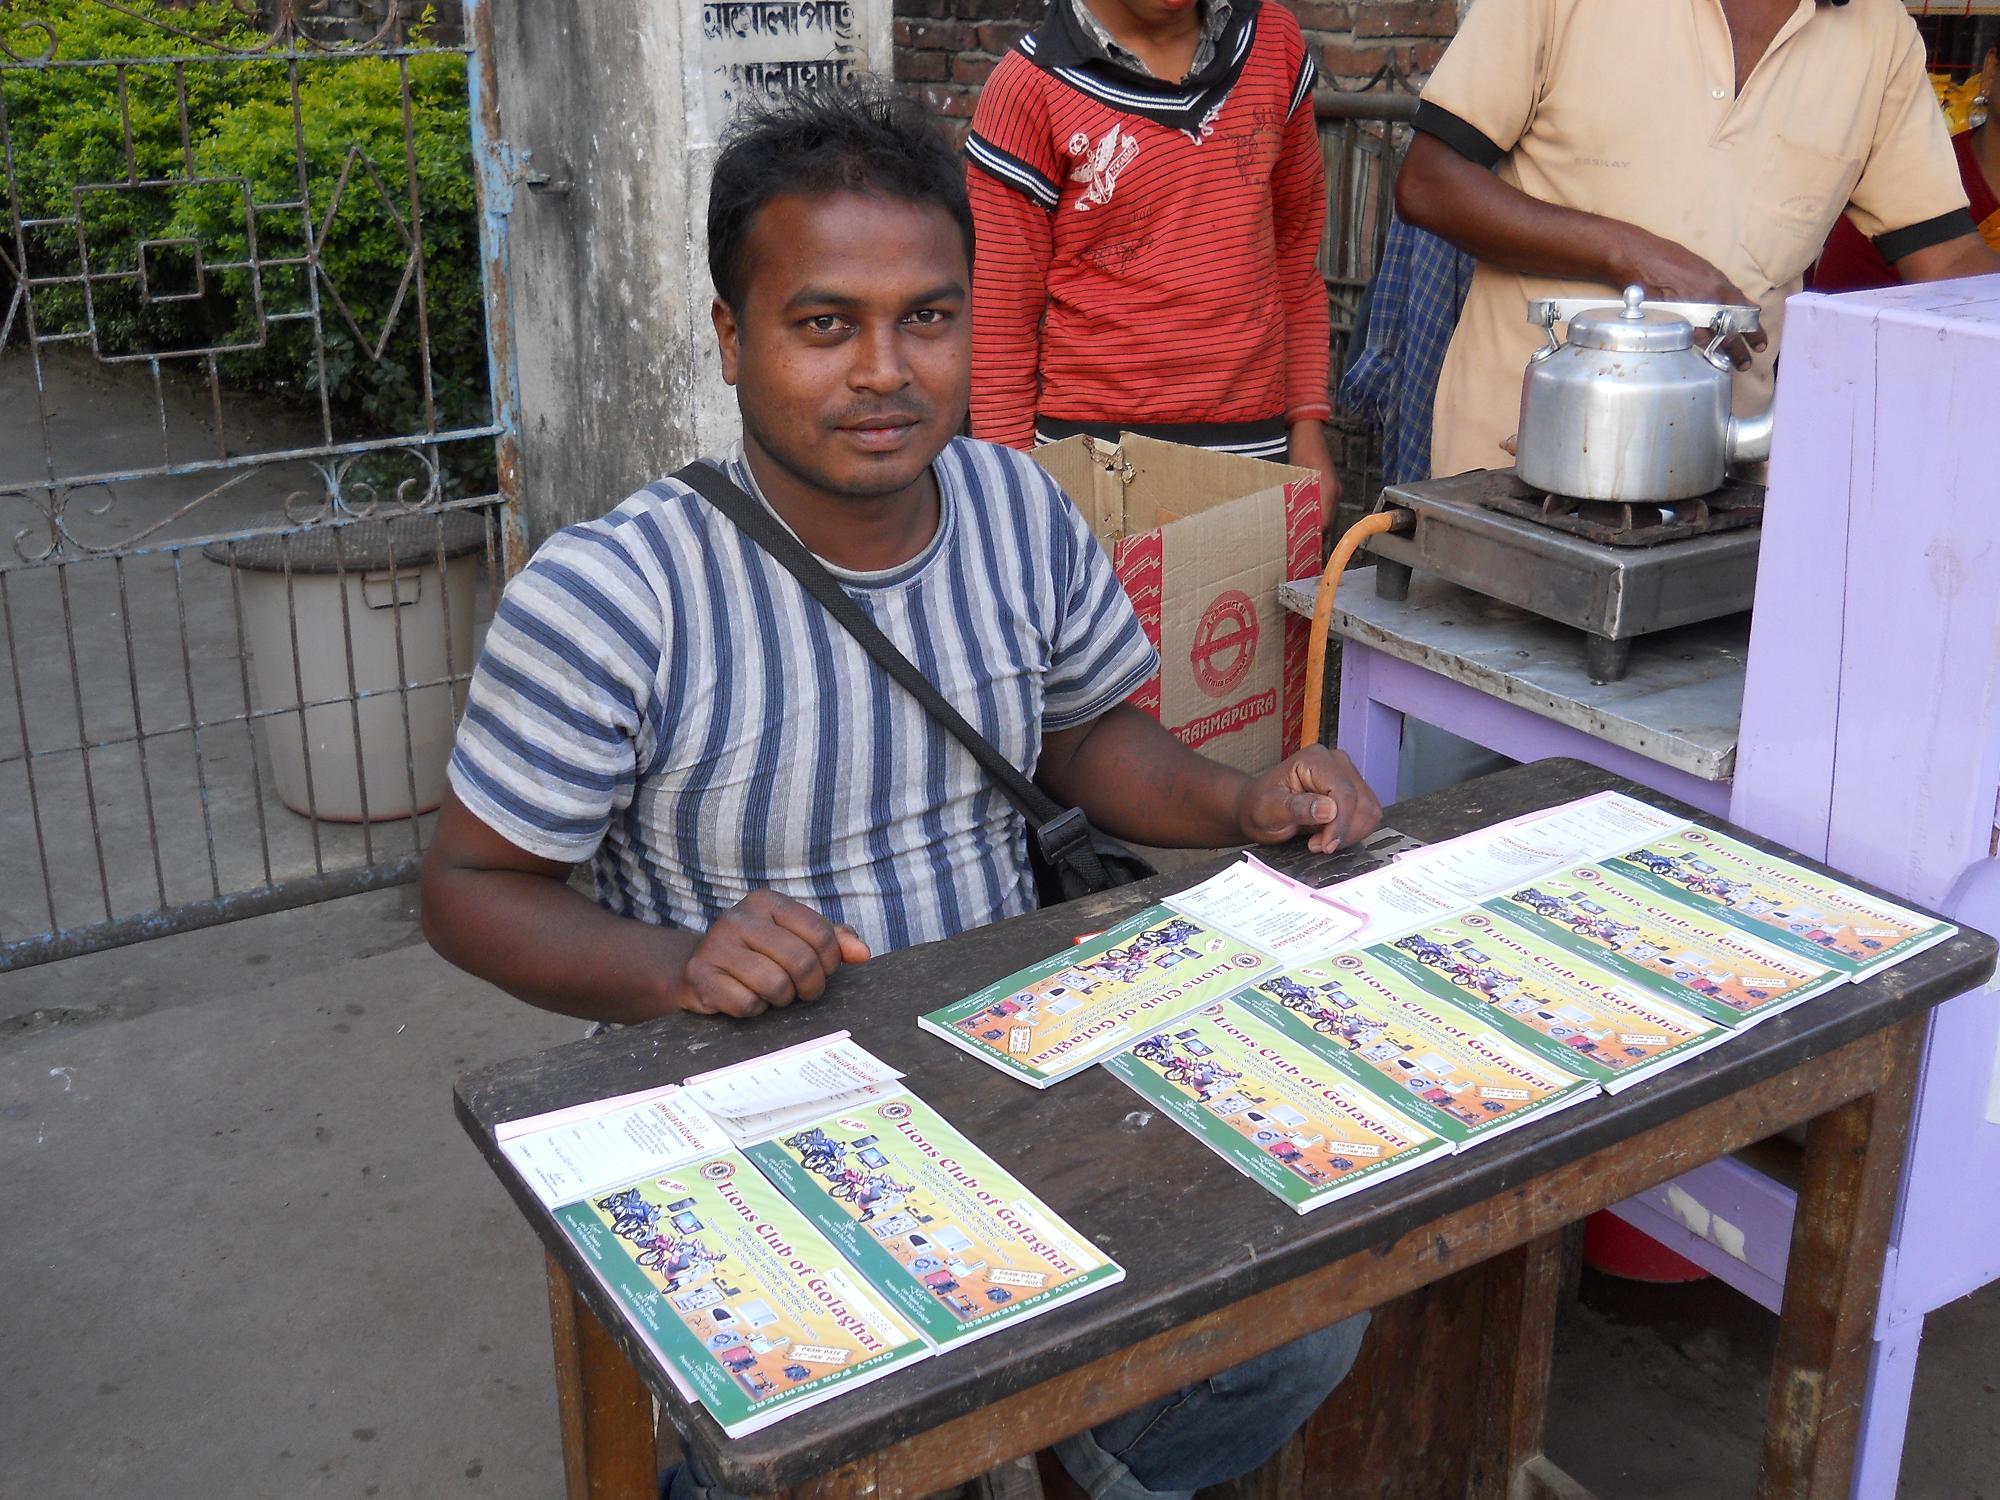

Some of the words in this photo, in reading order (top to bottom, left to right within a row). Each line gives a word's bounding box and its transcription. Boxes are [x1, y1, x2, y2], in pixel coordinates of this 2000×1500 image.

[1704, 841, 1750, 867] Lions
[1757, 864, 1798, 885] Club
[1800, 882, 1826, 894] of
[1826, 894, 1924, 935] Golaghat
[1598, 881, 1642, 907] Lions
[1647, 907, 1689, 928] Club
[1690, 925, 1716, 938] of
[1717, 937, 1810, 983] Golaghat
[1183, 963, 1231, 989] Lions
[1484, 927, 1530, 955] Lions
[1533, 955, 1575, 979] Club
[1575, 978, 1601, 992] of
[1601, 991, 1692, 1042] Golaghat
[1140, 989, 1183, 1009] Club
[1114, 1007, 1140, 1022] of
[942, 1021, 983, 1045] MEMBERS
[1027, 1019, 1117, 1066] Golaghat
[1354, 969, 1399, 1002] Lions
[1401, 1002, 1444, 1024] Club
[1441, 1024, 1469, 1039] of
[1467, 1039, 1556, 1094] Golaghat
[984, 1045, 1002, 1056] FOR
[1003, 1055, 1030, 1070] ONLY
[1212, 1016, 1258, 1048] Lions
[1258, 1048, 1300, 1075] Club
[1300, 1077, 1322, 1090] of
[1322, 1090, 1411, 1152] Golaghat
[1541, 1090, 1574, 1103] ONLY
[1517, 1103, 1539, 1113] FOR
[1467, 1112, 1517, 1133] MEMBERS
[1366, 1160, 1389, 1171] FOR
[1392, 1148, 1420, 1162] ONLY
[1310, 1170, 1364, 1193] MEMBERS
[896, 1120, 941, 1158] Lions
[938, 1158, 978, 1189] Club
[976, 1191, 1002, 1207] of
[995, 1208, 1077, 1281] Golaghat
[716, 1181, 758, 1223] Lions
[755, 1223, 793, 1257] Club
[790, 1259, 816, 1278] of
[807, 1278, 884, 1357] Golaghat
[1049, 1273, 1088, 1293] ONLY
[1022, 1289, 1050, 1305] FOR
[957, 1302, 1021, 1330] MEMBERS
[855, 1350, 893, 1370] ONLY
[822, 1368, 851, 1382] FOR
[748, 1380, 818, 1411] MEMBERS
